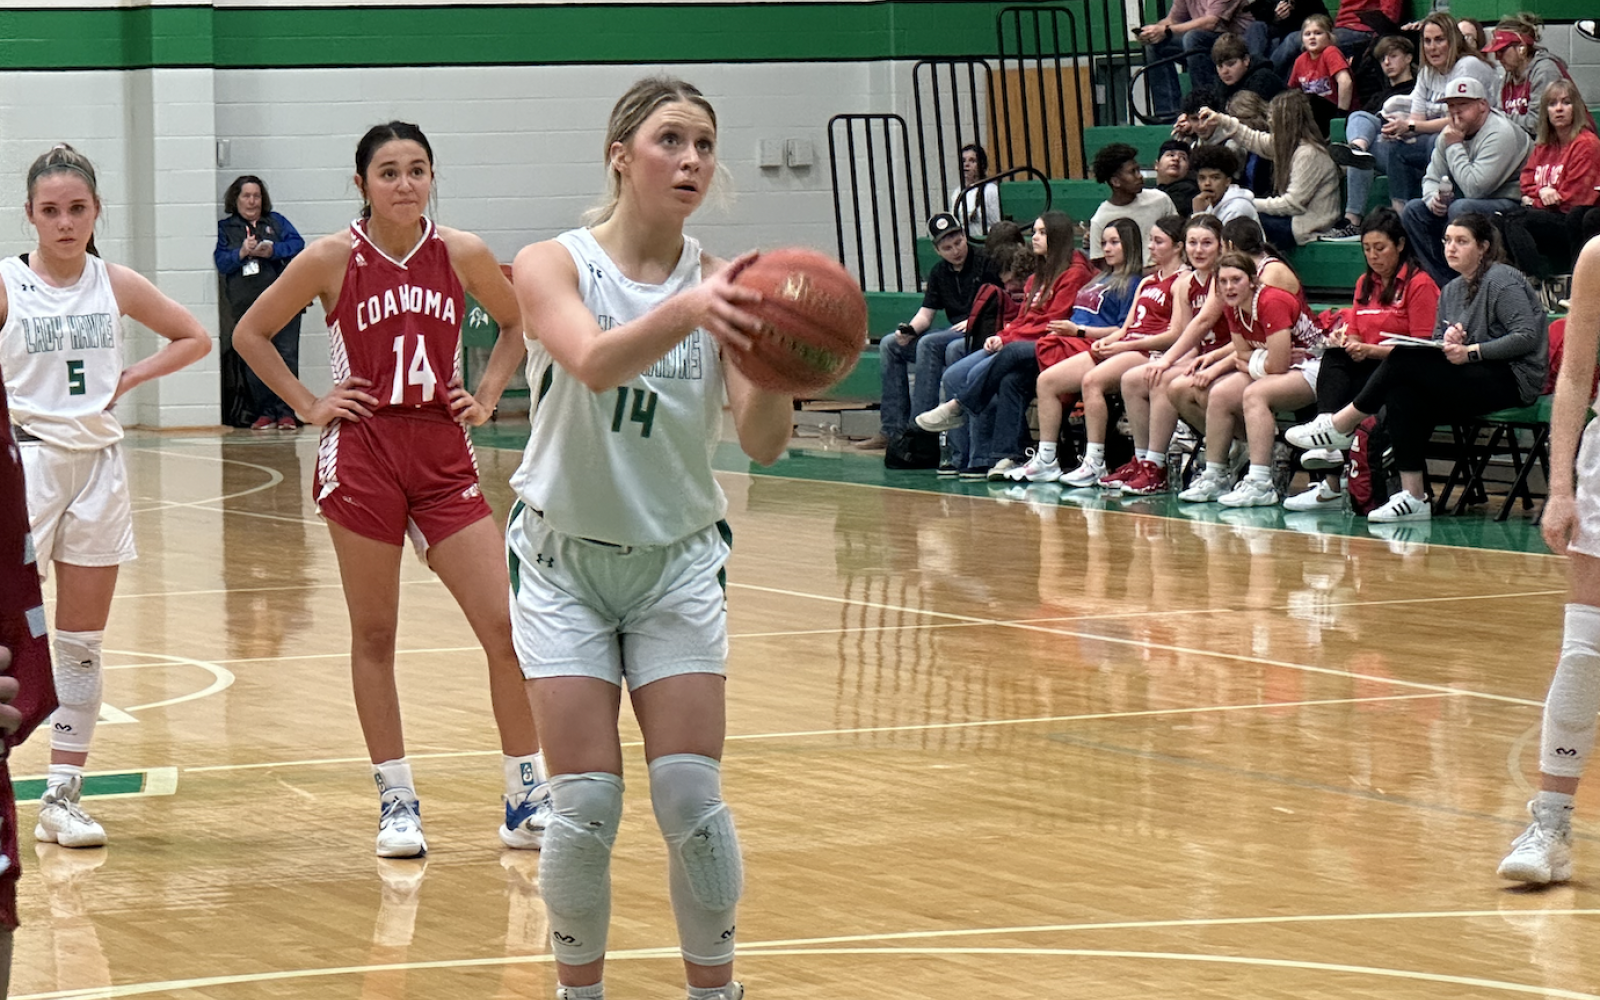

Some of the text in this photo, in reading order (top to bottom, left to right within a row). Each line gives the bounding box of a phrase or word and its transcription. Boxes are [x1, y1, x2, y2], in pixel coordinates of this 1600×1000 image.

[1458, 83, 1467, 93] C
[356, 283, 456, 332] COAHOMA
[22, 315, 64, 354] LADY
[66, 359, 86, 396] 5
[389, 333, 438, 405] 14
[611, 385, 659, 439] 14
